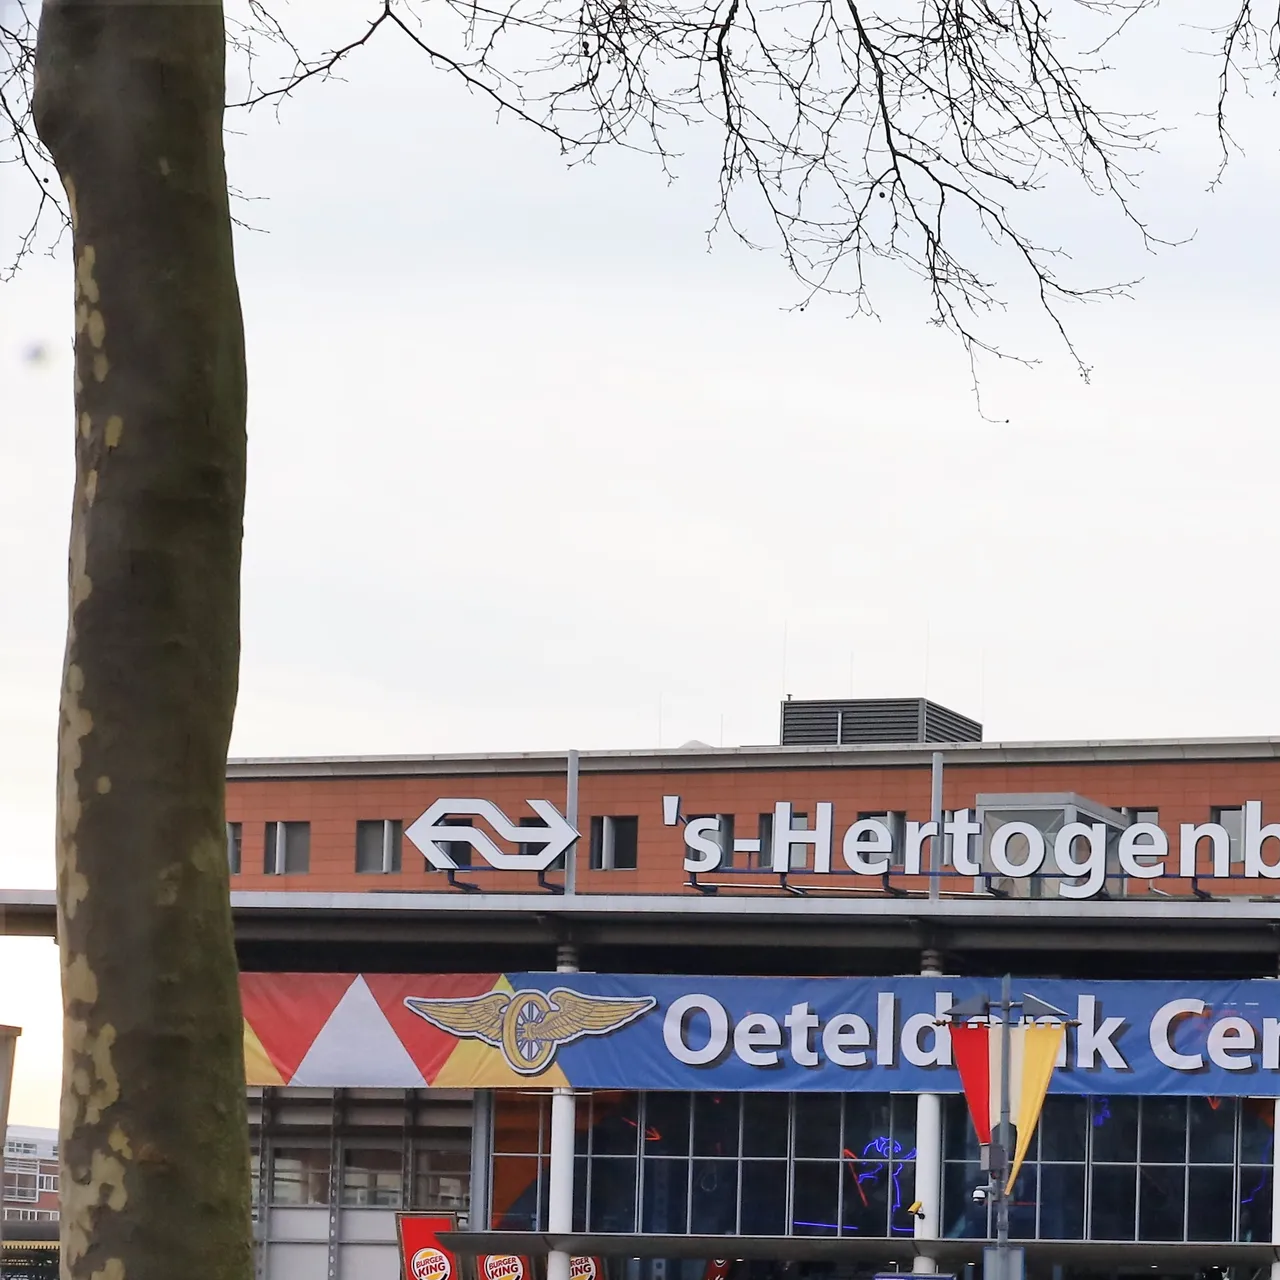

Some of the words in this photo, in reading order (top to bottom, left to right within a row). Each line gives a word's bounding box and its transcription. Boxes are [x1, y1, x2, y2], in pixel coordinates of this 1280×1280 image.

[663, 992, 1129, 1069] Oeteldk
[416, 1255, 444, 1268] BURGER
[489, 1256, 517, 1270] BURGER
[418, 1263, 446, 1278] KING
[491, 1265, 519, 1280] KING
[570, 1263, 592, 1277] ING
